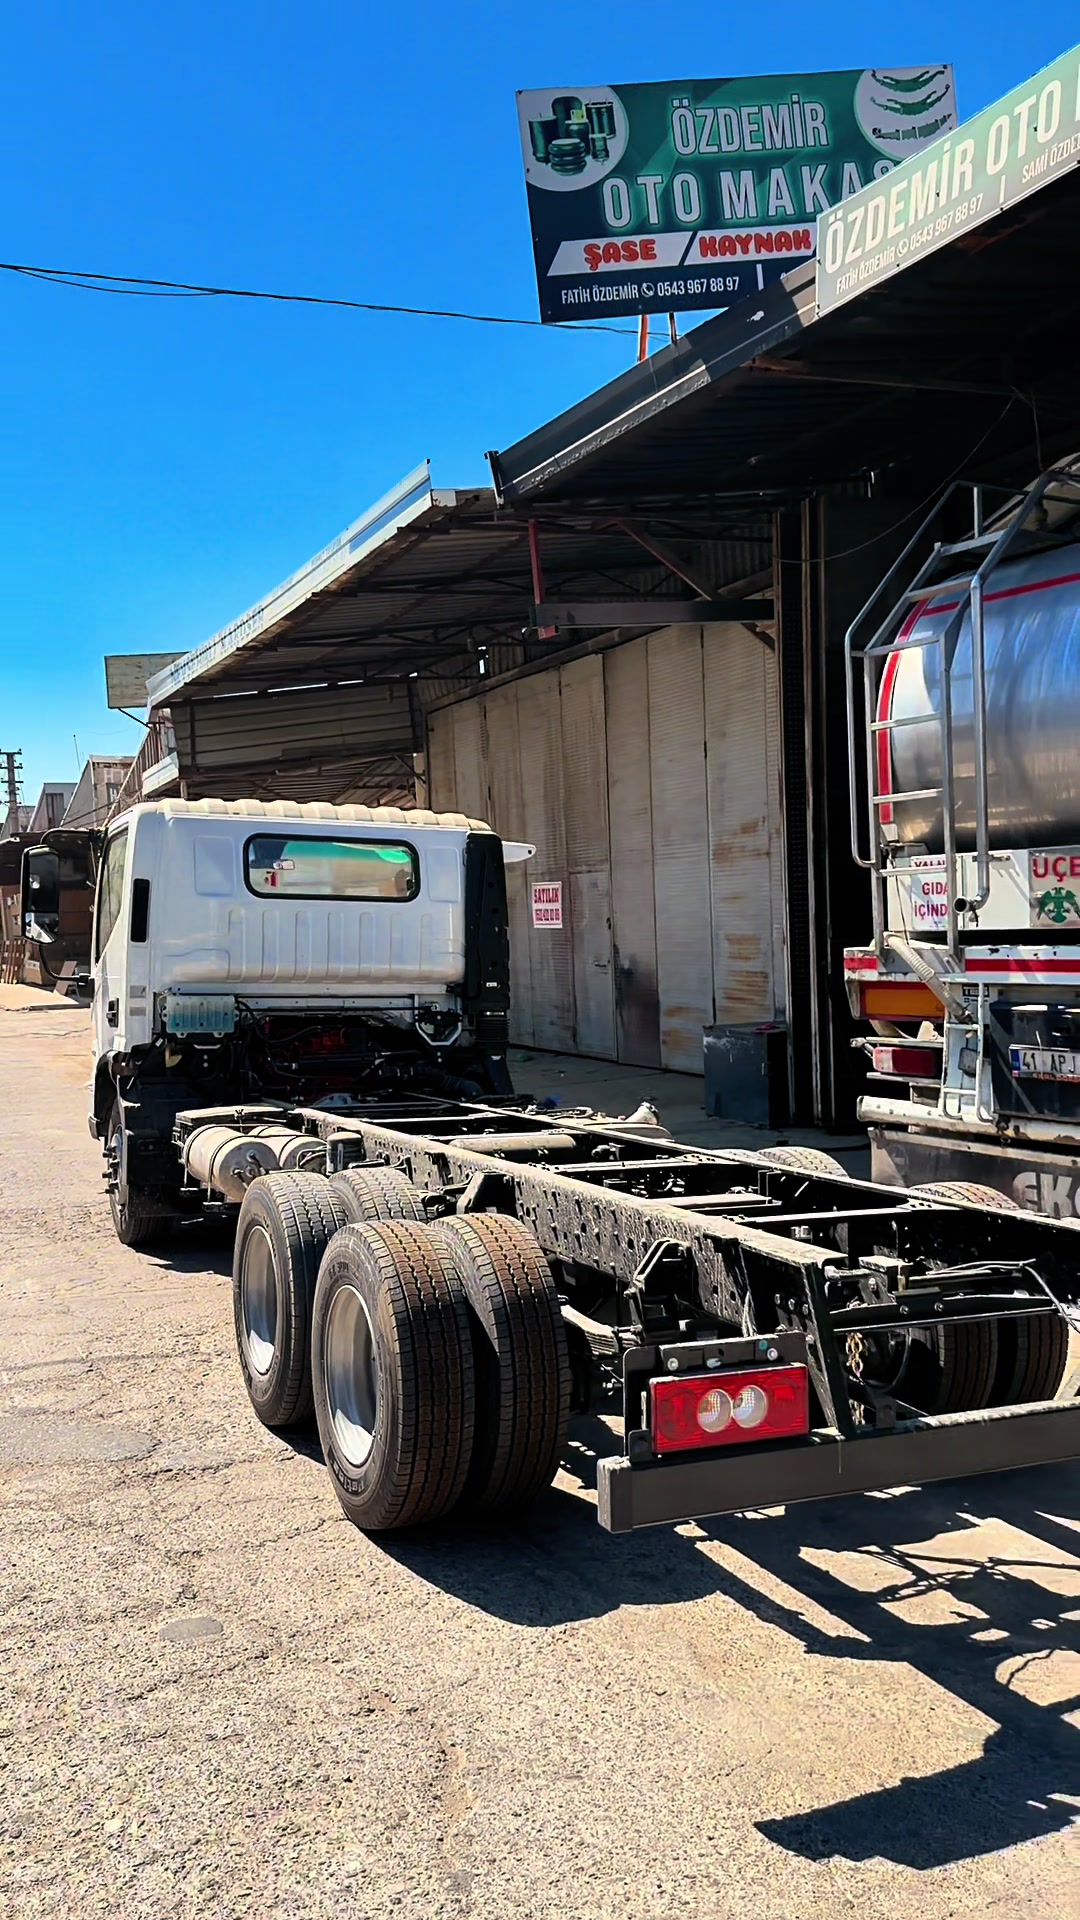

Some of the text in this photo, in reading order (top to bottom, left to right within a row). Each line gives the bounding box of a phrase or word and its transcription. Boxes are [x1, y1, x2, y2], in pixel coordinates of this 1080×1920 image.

[672, 95, 829, 155] ÖZDEMİR
[825, 140, 975, 274] ÖZDEMİR
[986, 80, 1062, 176] OTO
[1022, 149, 1049, 183] SAMİ
[603, 172, 701, 227] OTO
[584, 229, 811, 271] ŞASE KAYNAK
[836, 193, 984, 295] FATİH ÖZDEMİR 0543 967 88 97
[561, 276, 739, 304] FATİH ÖZDEMİR 0543 967 88 97
[1022, 1052, 1037, 1071] 41
